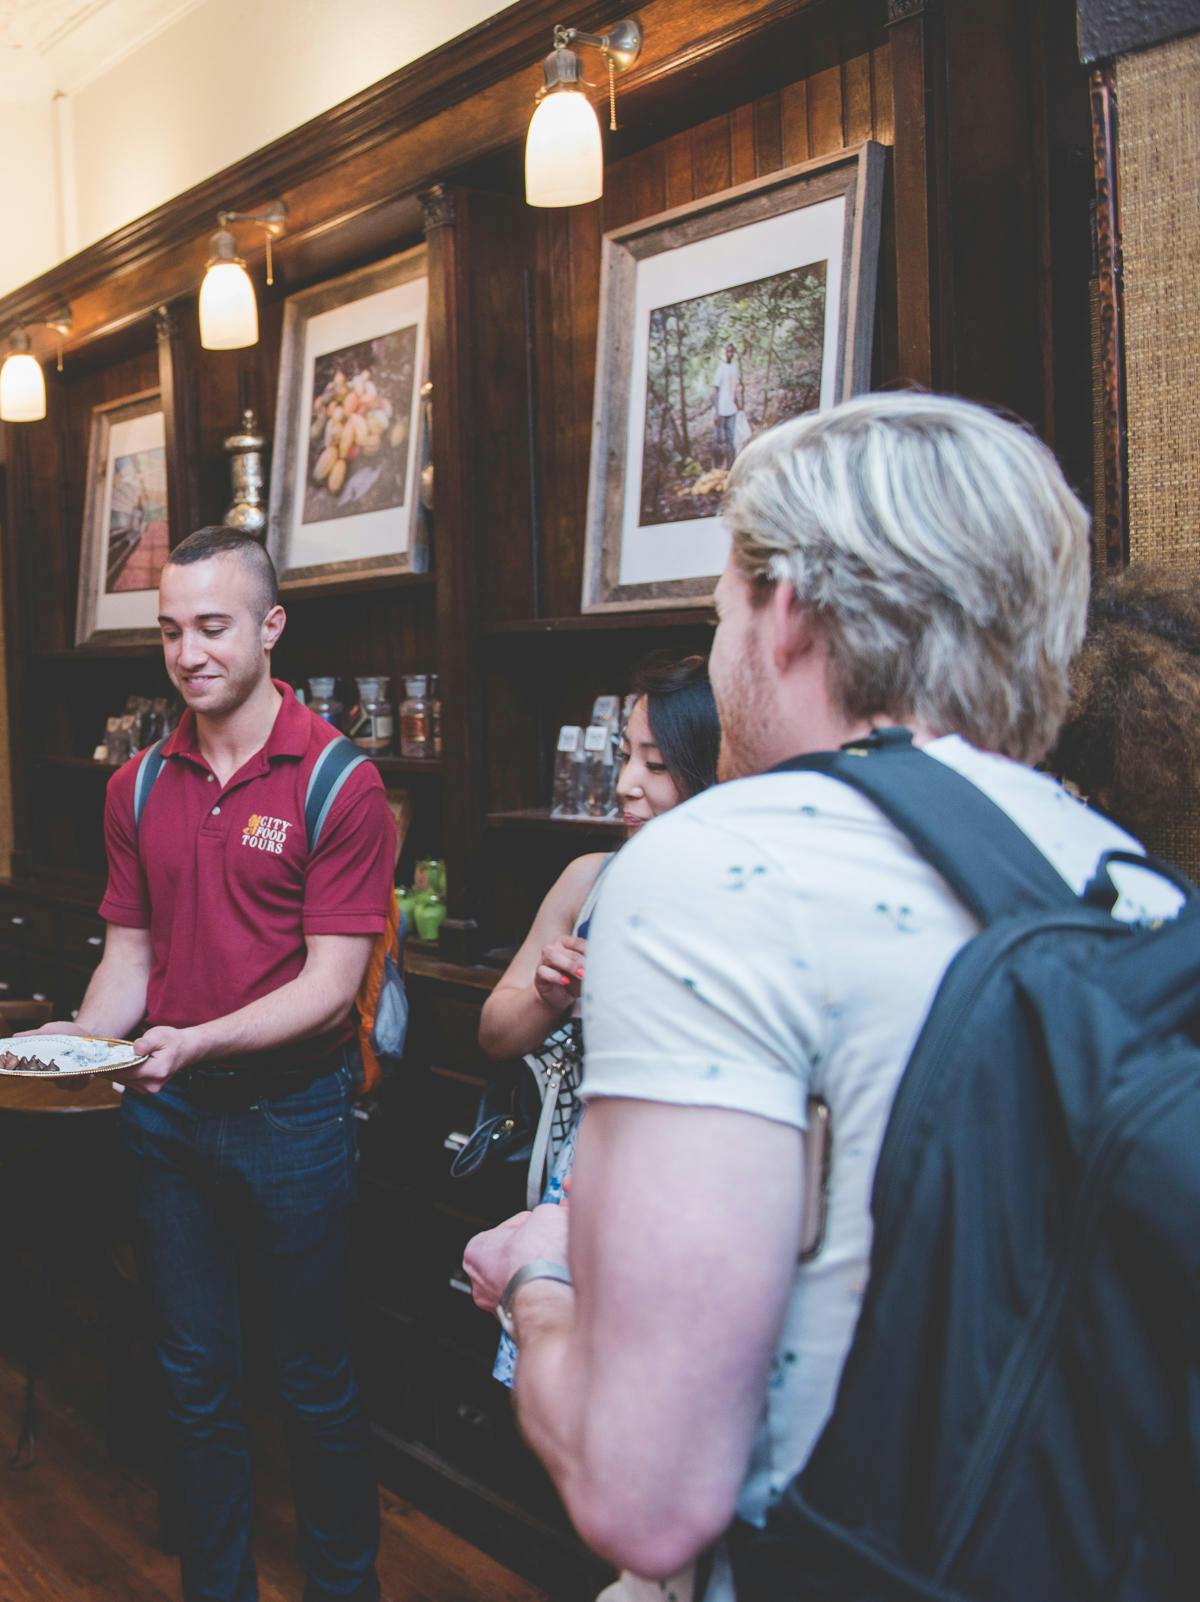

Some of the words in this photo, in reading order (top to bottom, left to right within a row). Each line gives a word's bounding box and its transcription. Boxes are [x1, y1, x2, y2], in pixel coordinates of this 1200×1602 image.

[260, 816, 293, 832] CITY
[255, 827, 286, 843] FOOD
[242, 835, 283, 854] TOURS
